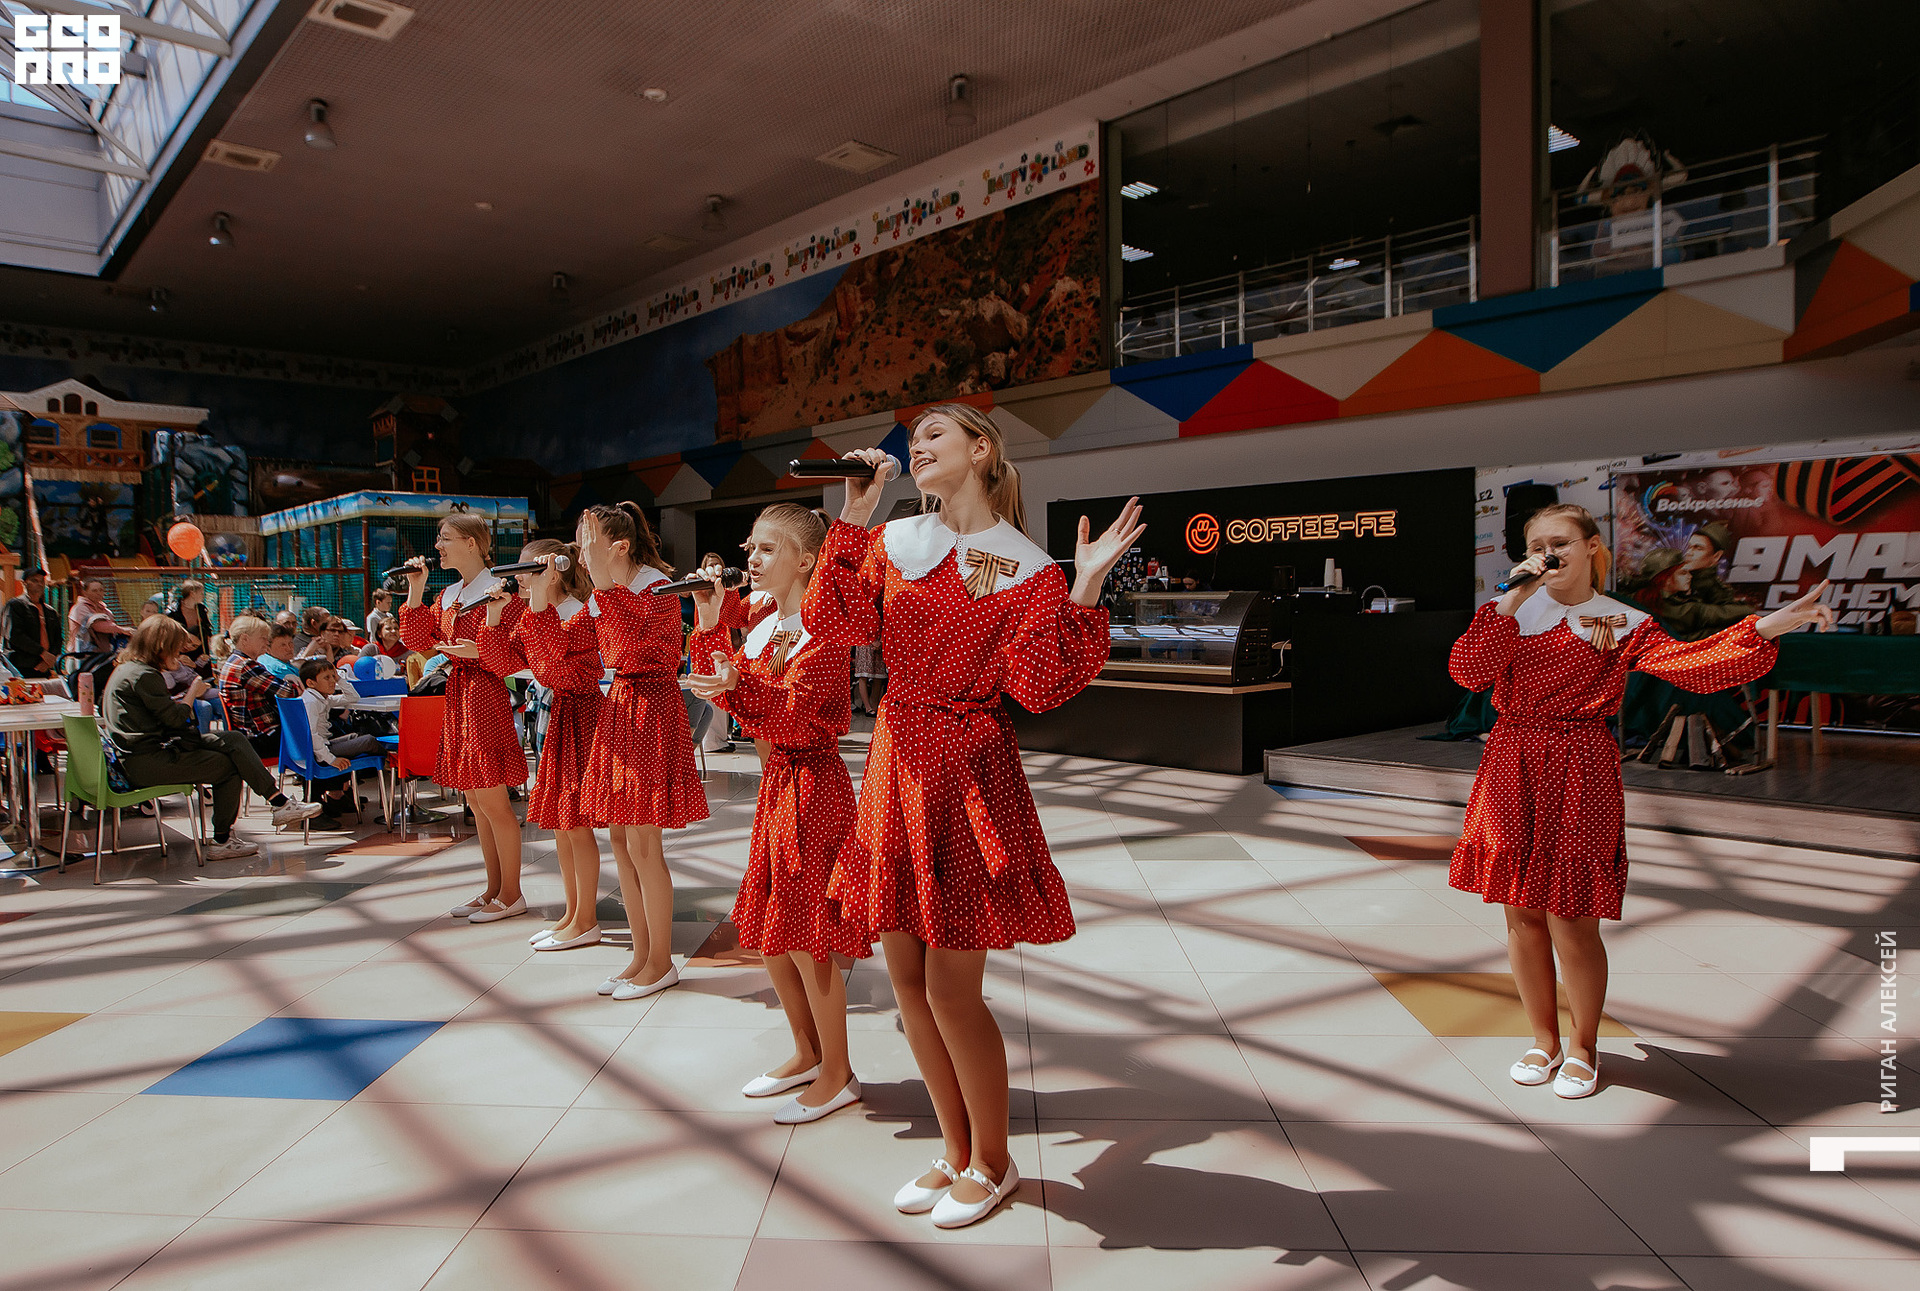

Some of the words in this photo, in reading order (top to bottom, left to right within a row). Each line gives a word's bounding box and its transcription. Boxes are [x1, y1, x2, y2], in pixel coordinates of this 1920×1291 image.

[987, 164, 1028, 195] HAPPY
[1050, 142, 1091, 171] LAND
[876, 209, 910, 235] HAPPY
[928, 190, 960, 216] LAND
[1656, 495, 1764, 513] Воскресенье
[1225, 510, 1397, 544] COFFEE-FE
